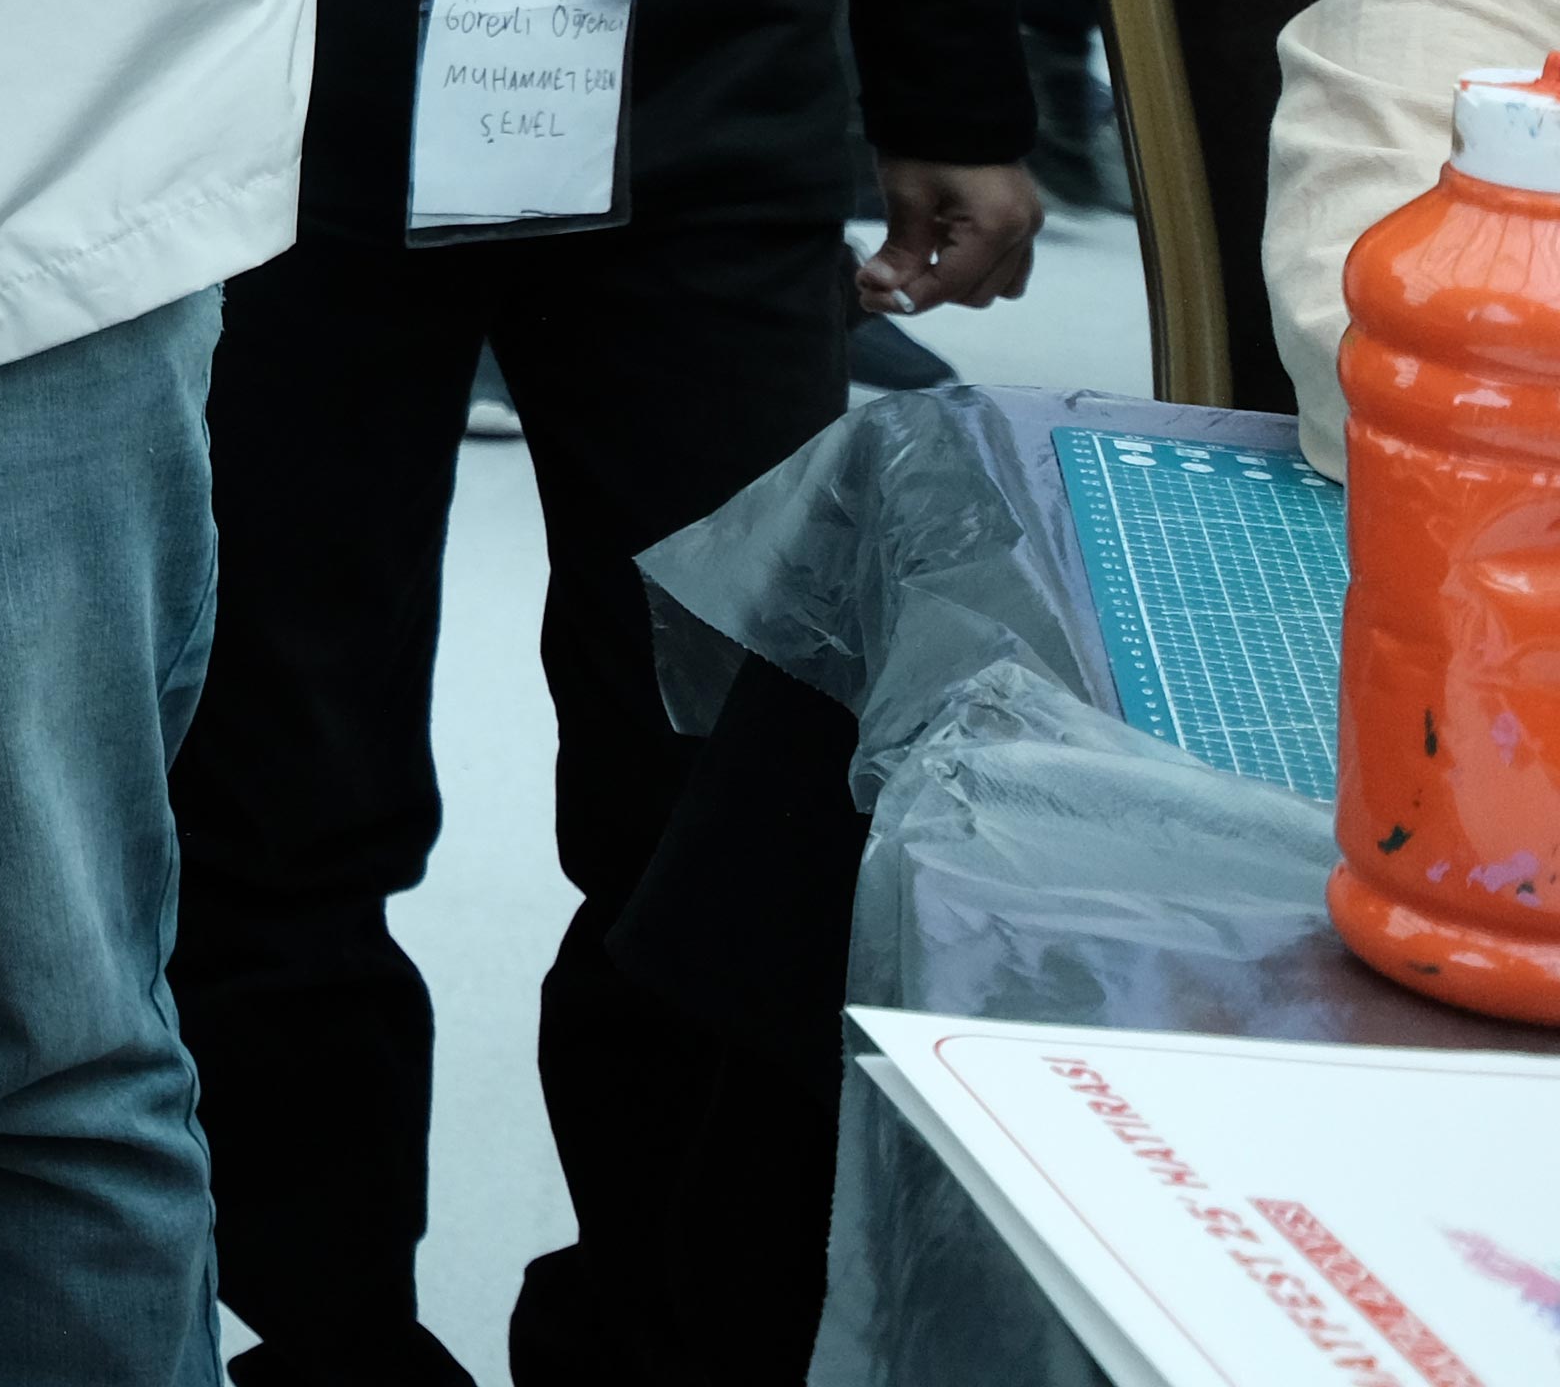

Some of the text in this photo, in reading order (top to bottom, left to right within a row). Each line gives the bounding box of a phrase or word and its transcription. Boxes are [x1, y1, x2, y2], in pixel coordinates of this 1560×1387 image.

[443, 65, 576, 93] MUHAMMET
[480, 111, 566, 144] ŞENEL
[1040, 1055, 1209, 1191] HATIRASI
[1229, 1248, 1406, 1387] ATFEST
